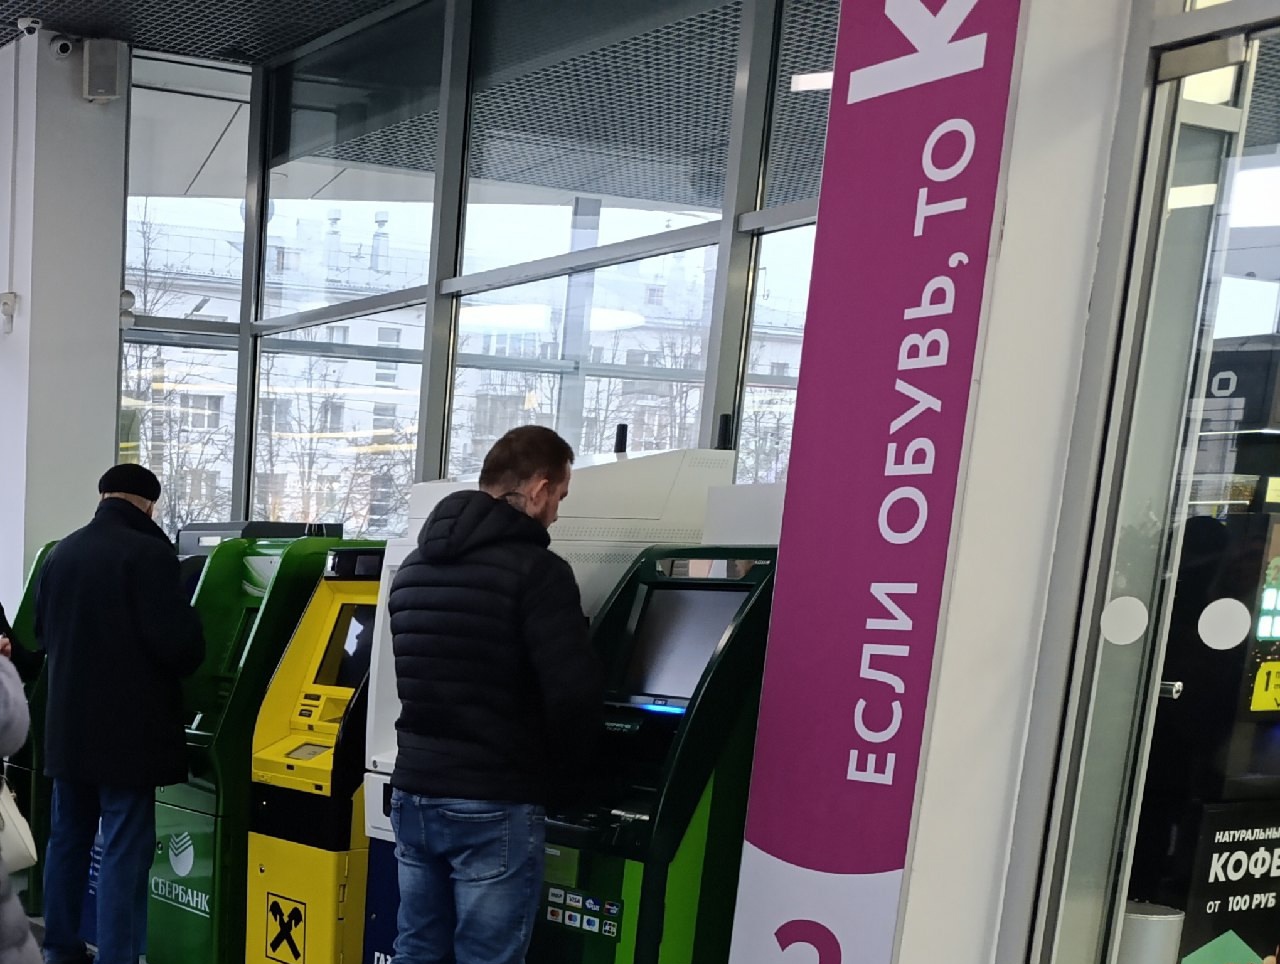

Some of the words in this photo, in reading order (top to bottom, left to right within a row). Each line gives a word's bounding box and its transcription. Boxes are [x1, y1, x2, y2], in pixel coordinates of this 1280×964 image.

[914, 118, 976, 237] ТО
[878, 252, 970, 545] ОБУВЬ,
[847, 583, 918, 786] ЕСЛИ
[151, 876, 210, 913] СБЕРБАНК
[1206, 900, 1221, 914] ОТ
[1228, 894, 1250, 912] 100
[1251, 891, 1277, 910] РУБ
[1208, 846, 1280, 884] КОФЕ
